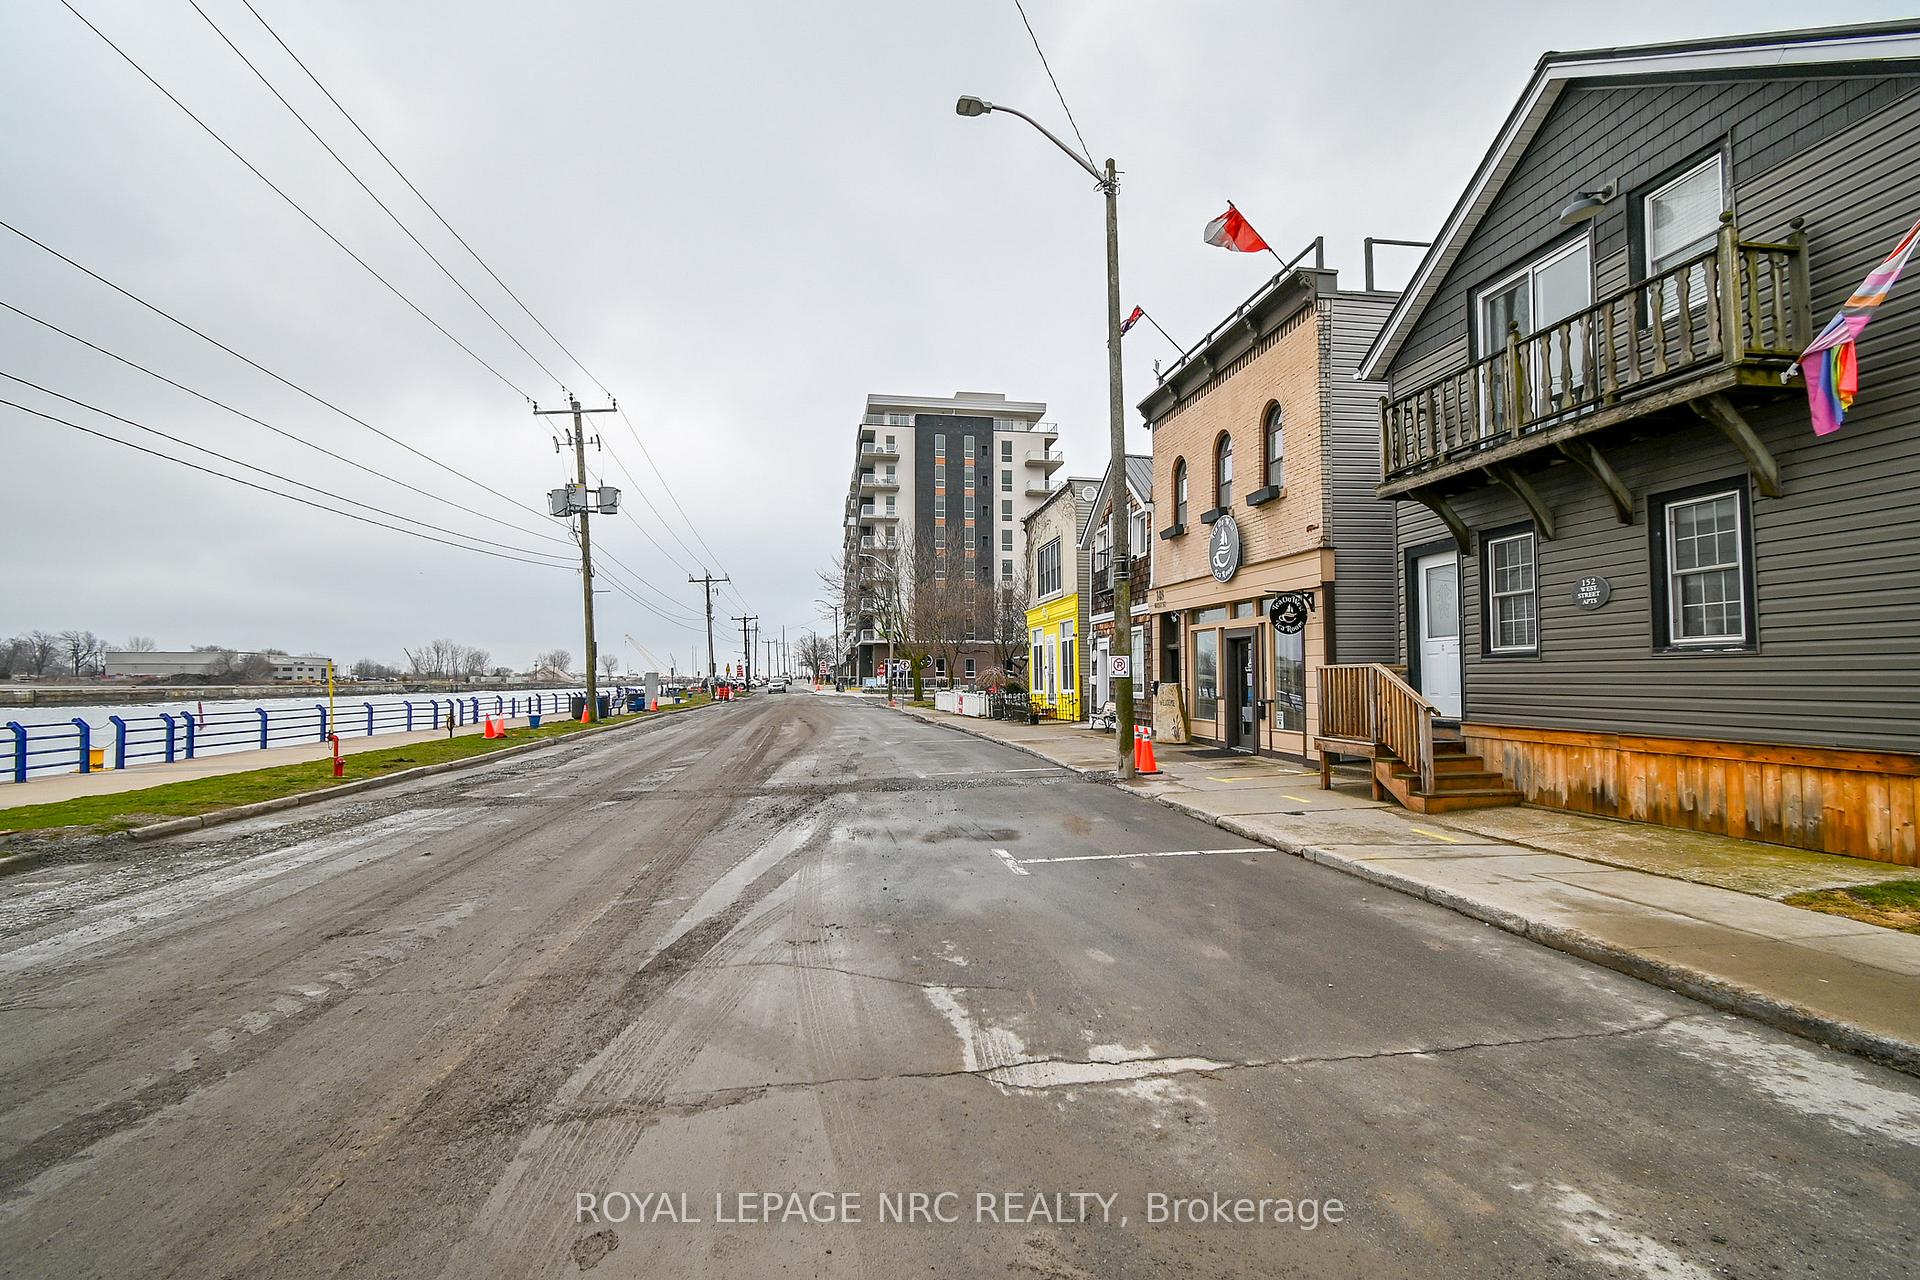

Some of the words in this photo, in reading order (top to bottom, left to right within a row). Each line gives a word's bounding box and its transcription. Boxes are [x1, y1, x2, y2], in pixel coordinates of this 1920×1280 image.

[1582, 578, 1596, 586] 152
[1577, 591, 1601, 600] STREET
[1275, 620, 1285, 631] Tea
[1286, 621, 1304, 633] Room
